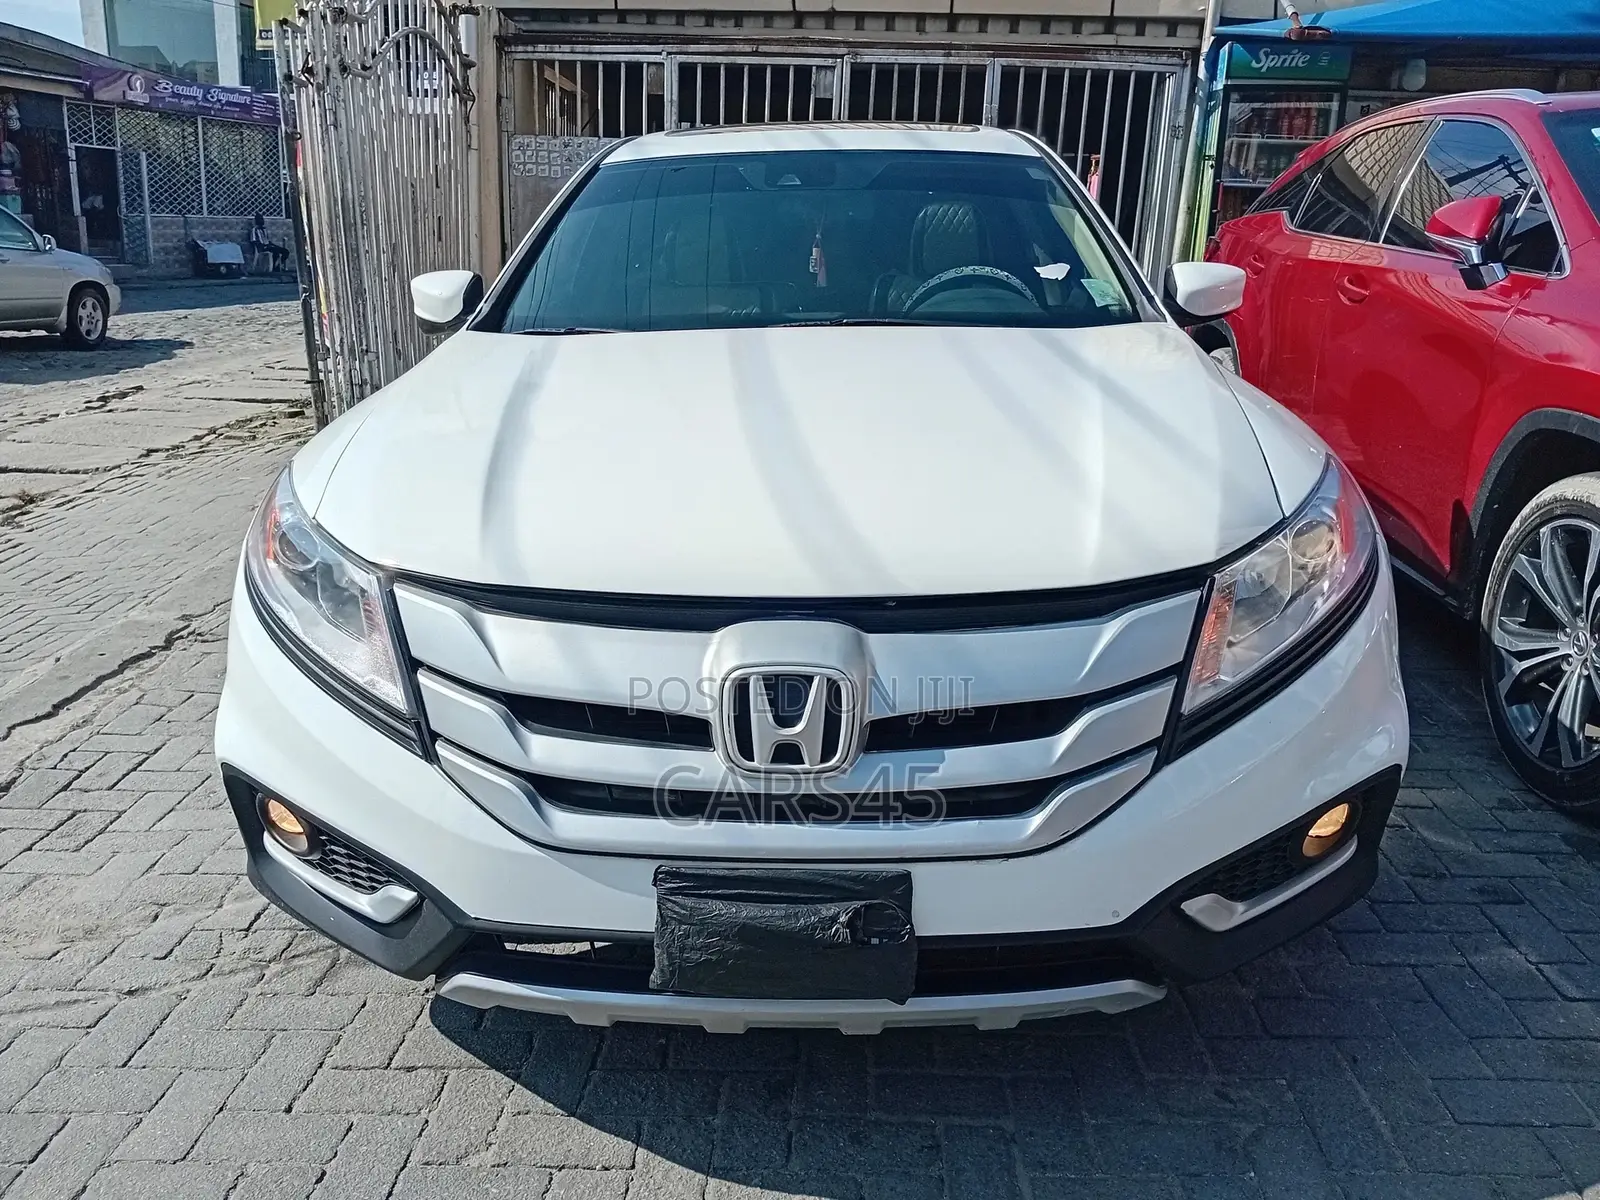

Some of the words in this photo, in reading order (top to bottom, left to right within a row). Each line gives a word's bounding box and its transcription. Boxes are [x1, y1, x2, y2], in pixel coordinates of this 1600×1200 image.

[1251, 48, 1311, 73] Sprite
[153, 79, 202, 101] Beauty
[207, 88, 252, 105] Signature
